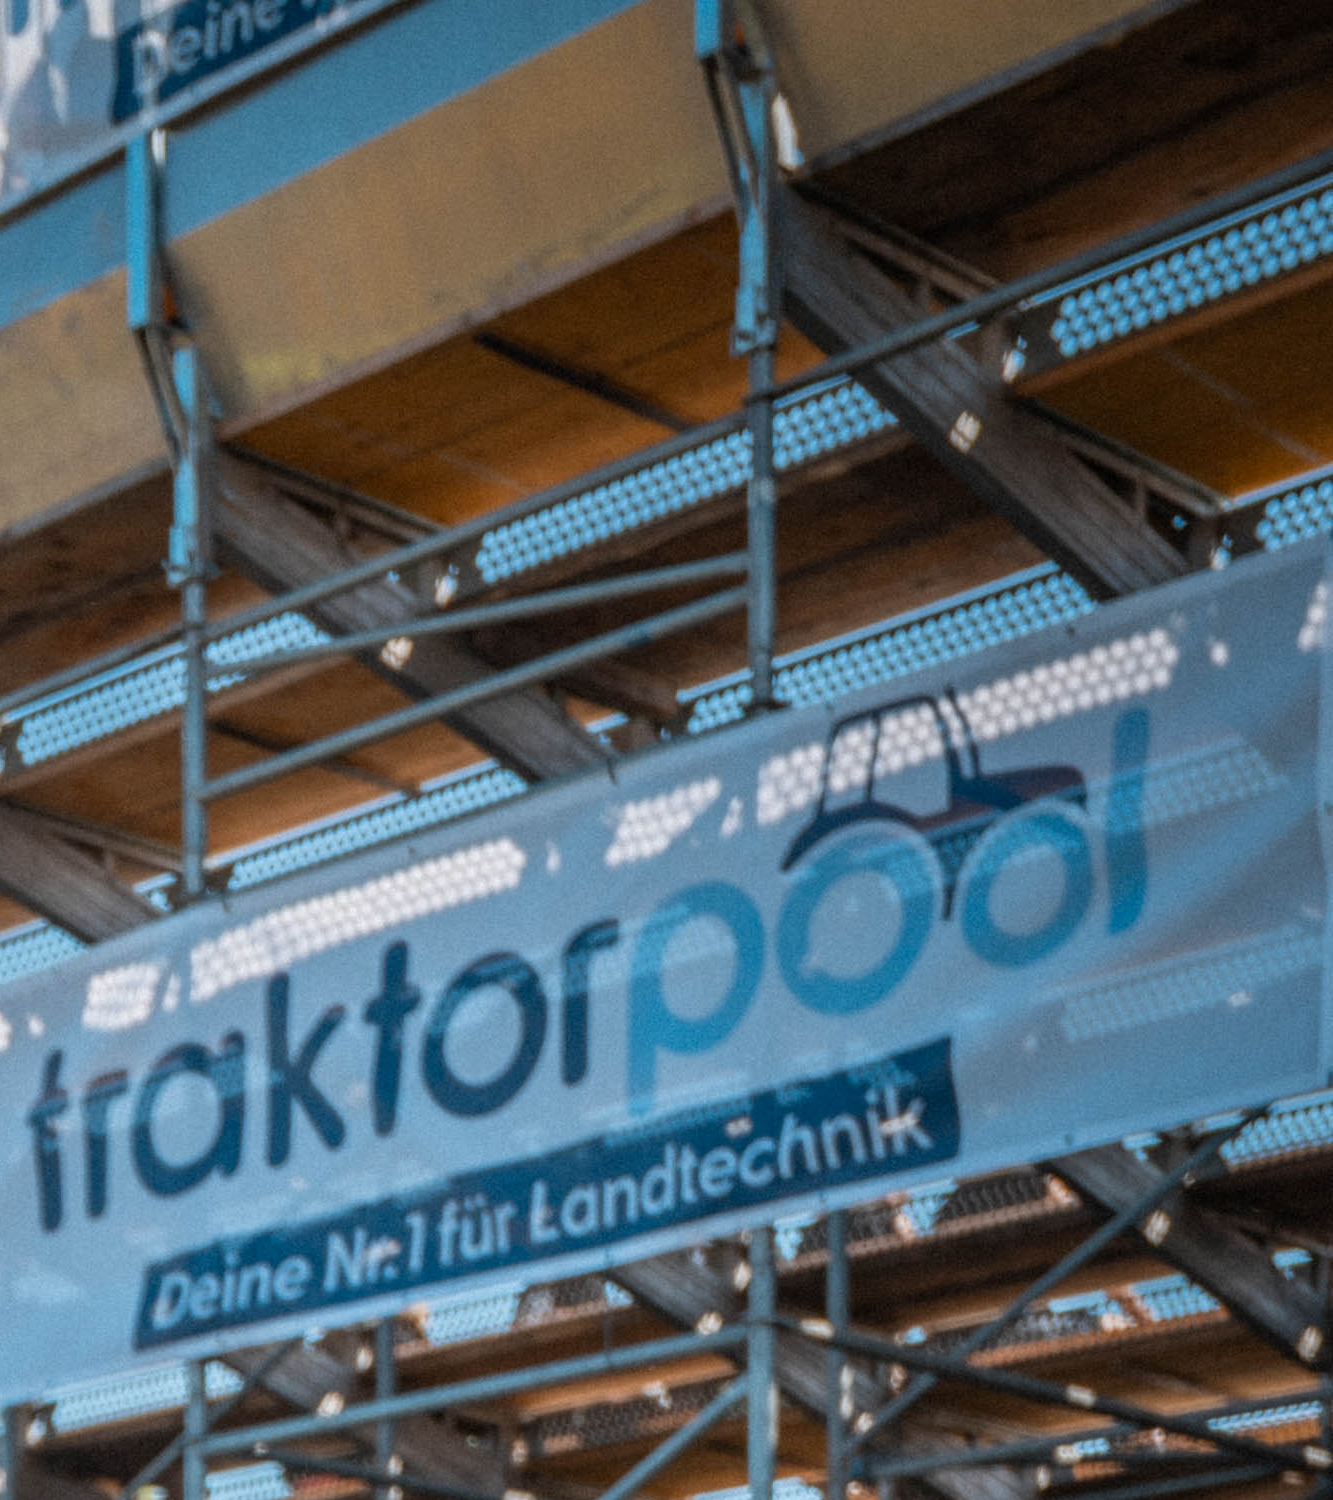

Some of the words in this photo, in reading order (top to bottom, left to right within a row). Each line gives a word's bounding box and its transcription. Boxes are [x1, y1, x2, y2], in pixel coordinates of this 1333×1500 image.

[25, 708, 1151, 1234] traktorpool
[151, 1248, 312, 1330] Deine
[437, 1195, 516, 1267] für
[533, 1085, 933, 1243] Landtechnik
